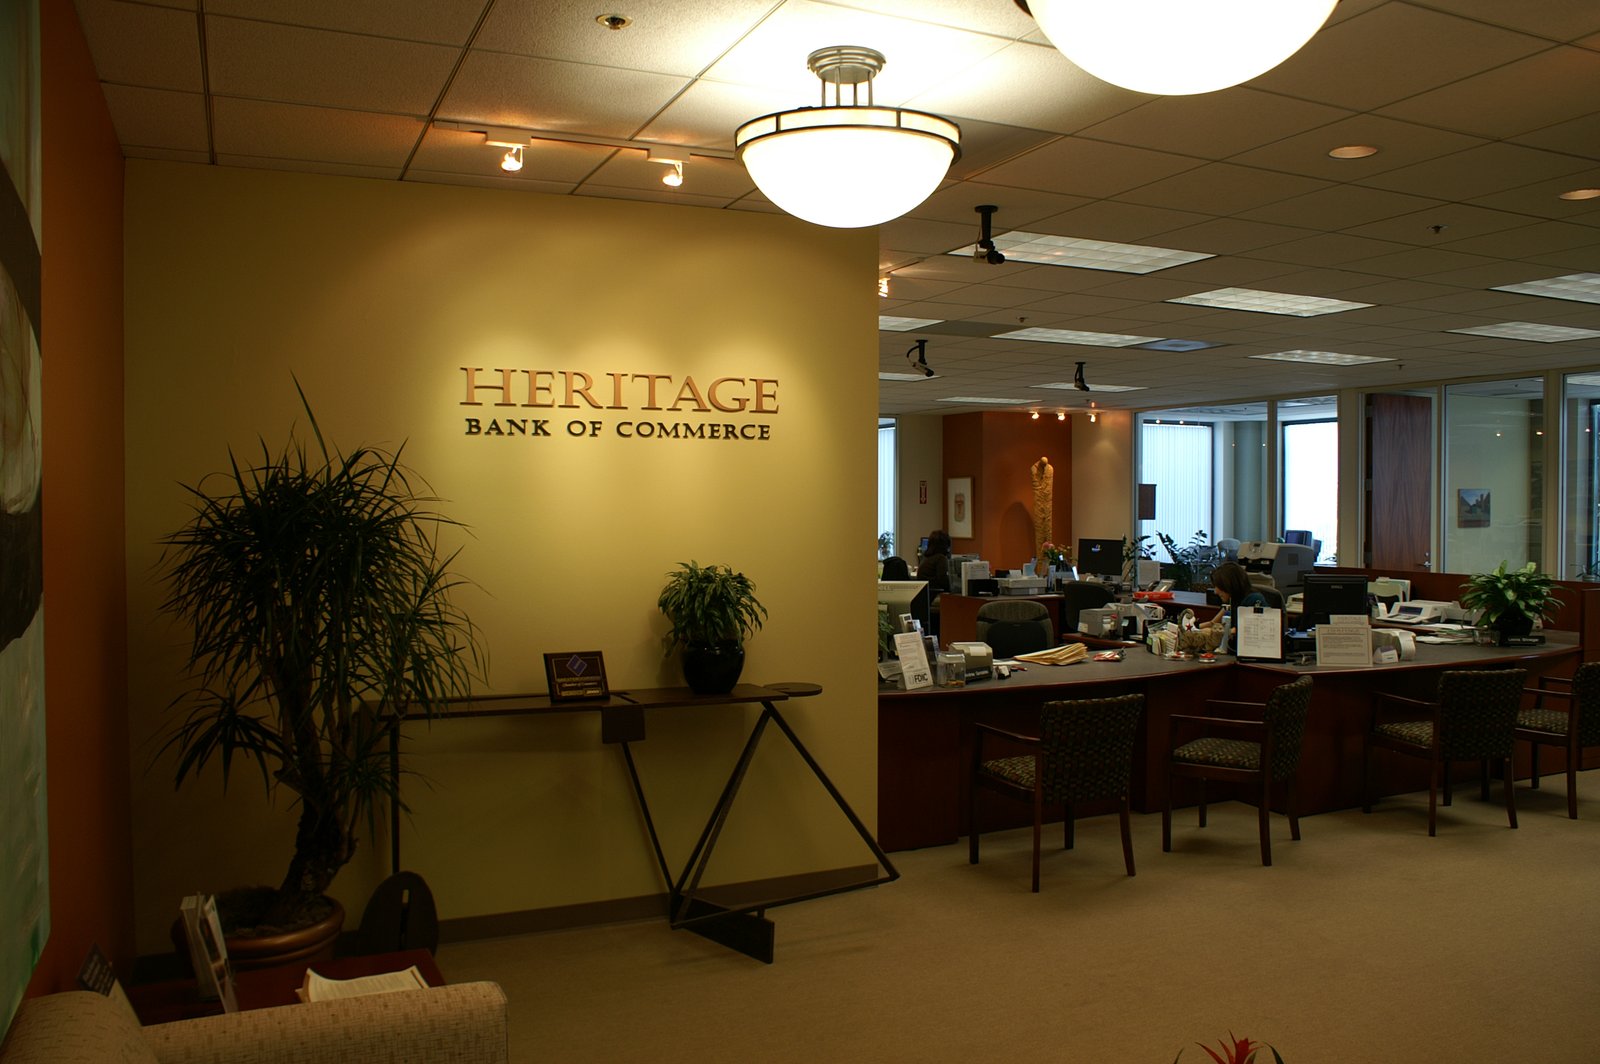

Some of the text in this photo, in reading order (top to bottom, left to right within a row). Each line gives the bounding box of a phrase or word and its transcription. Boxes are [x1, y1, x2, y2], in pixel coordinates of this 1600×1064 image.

[459, 366, 779, 414] HERITAGE
[465, 418, 771, 441] BANK OF COMMERCE
[914, 673, 928, 683] FDIC
